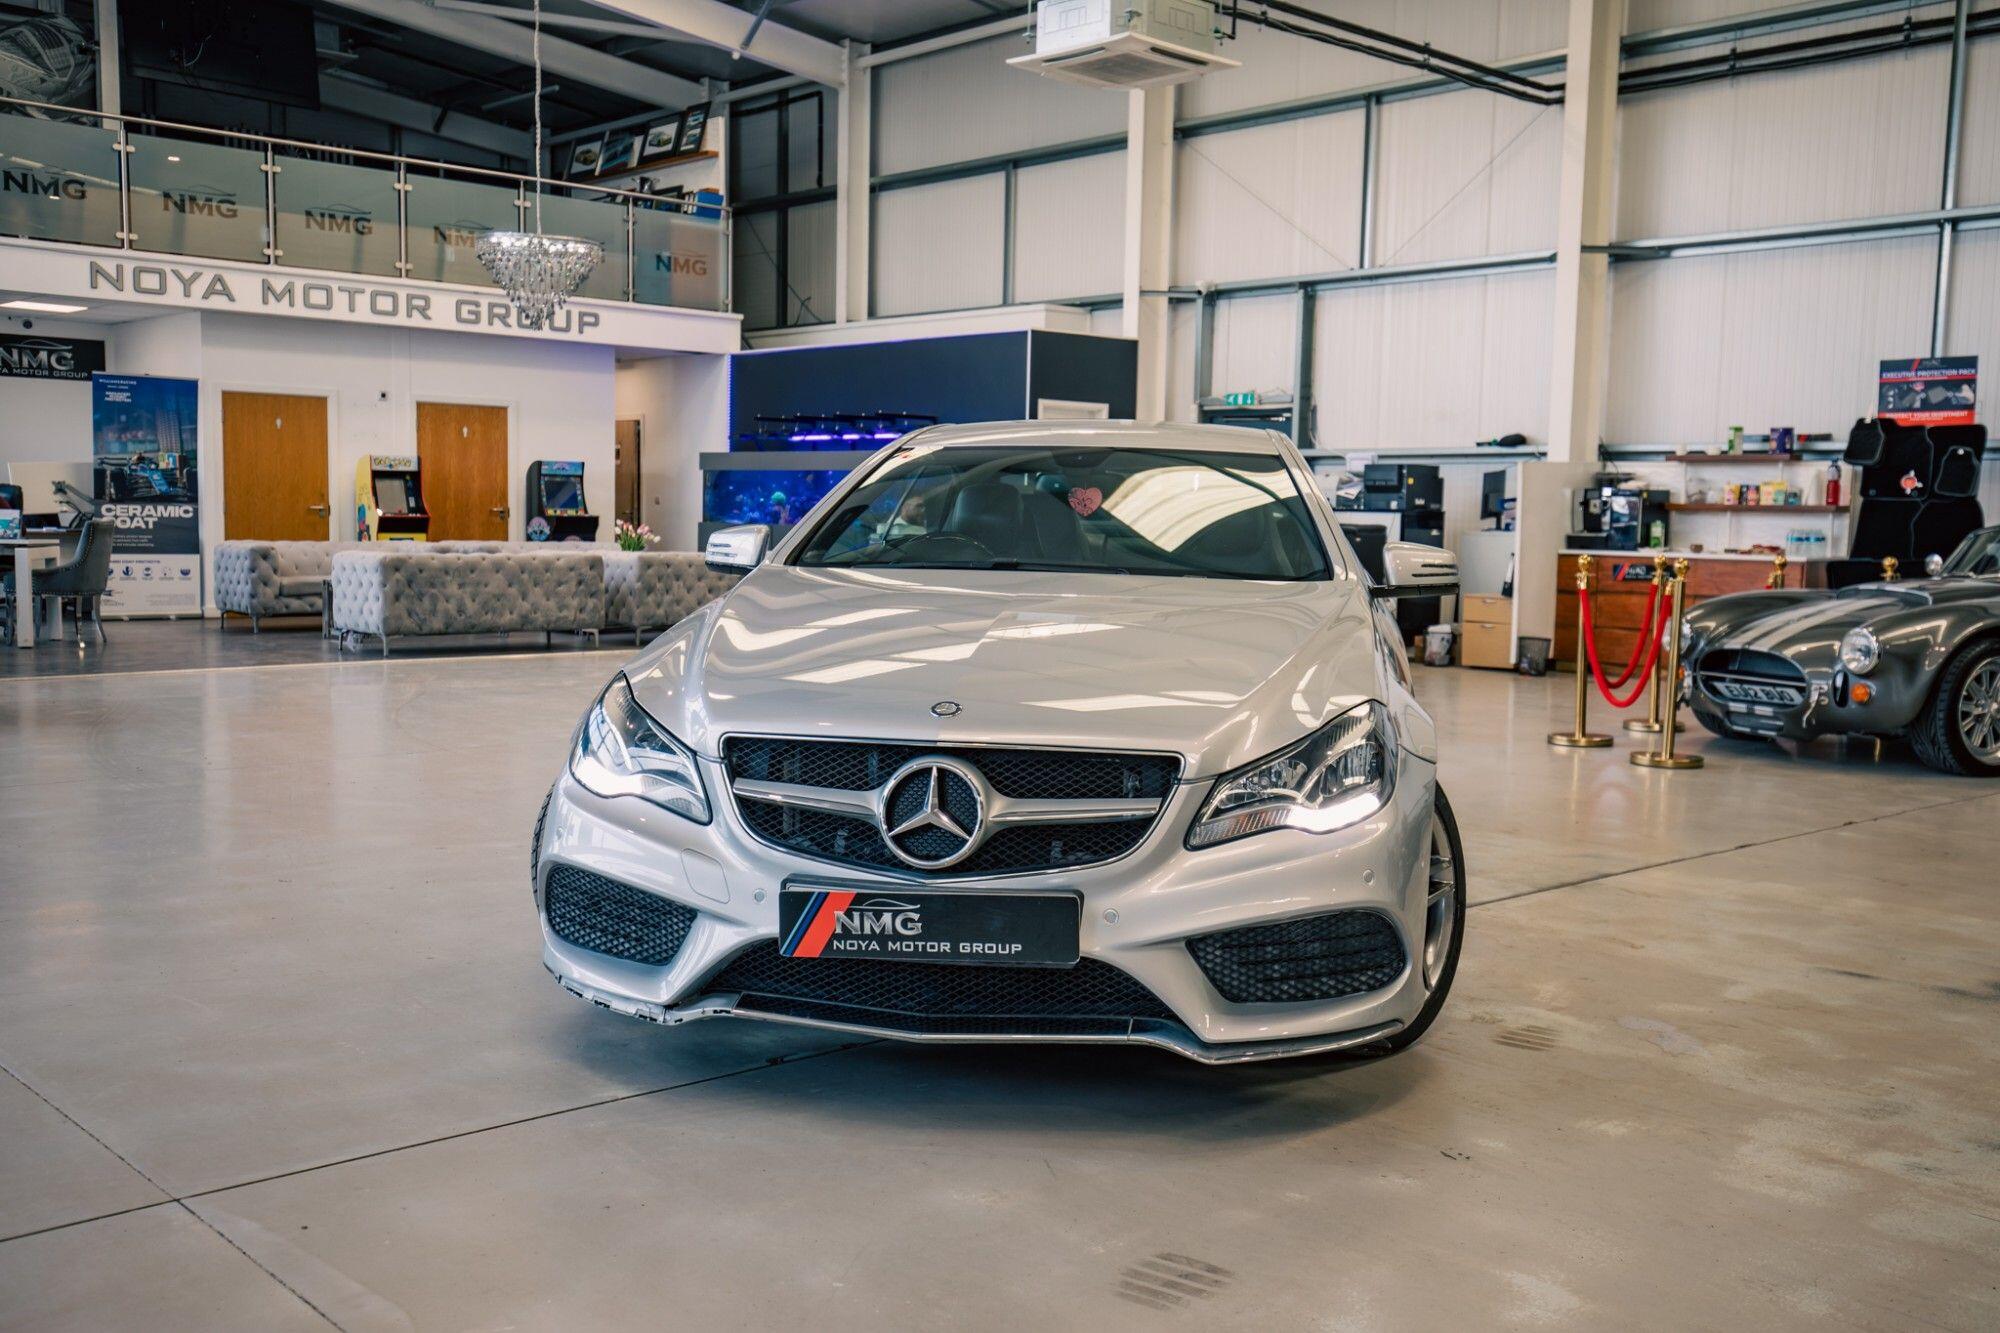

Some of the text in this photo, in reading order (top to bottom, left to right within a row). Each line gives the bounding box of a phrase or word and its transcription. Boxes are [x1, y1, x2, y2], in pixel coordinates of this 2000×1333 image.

[2, 169, 87, 201] NMG
[162, 192, 238, 219] NMG
[304, 210, 374, 236] NMG
[433, 226, 476, 249] NM
[656, 253, 707, 277] NMG
[89, 261, 236, 303] NOYA
[261, 278, 432, 321] MOTOR
[0, 348, 75, 370] NMG
[13, 368, 49, 377] MOTOR
[53, 370, 89, 379] GROUP
[101, 504, 194, 518] CERAMIC
[834, 909, 922, 935] NMG
[833, 939, 1022, 955] NOYA MOTOR GROUP
